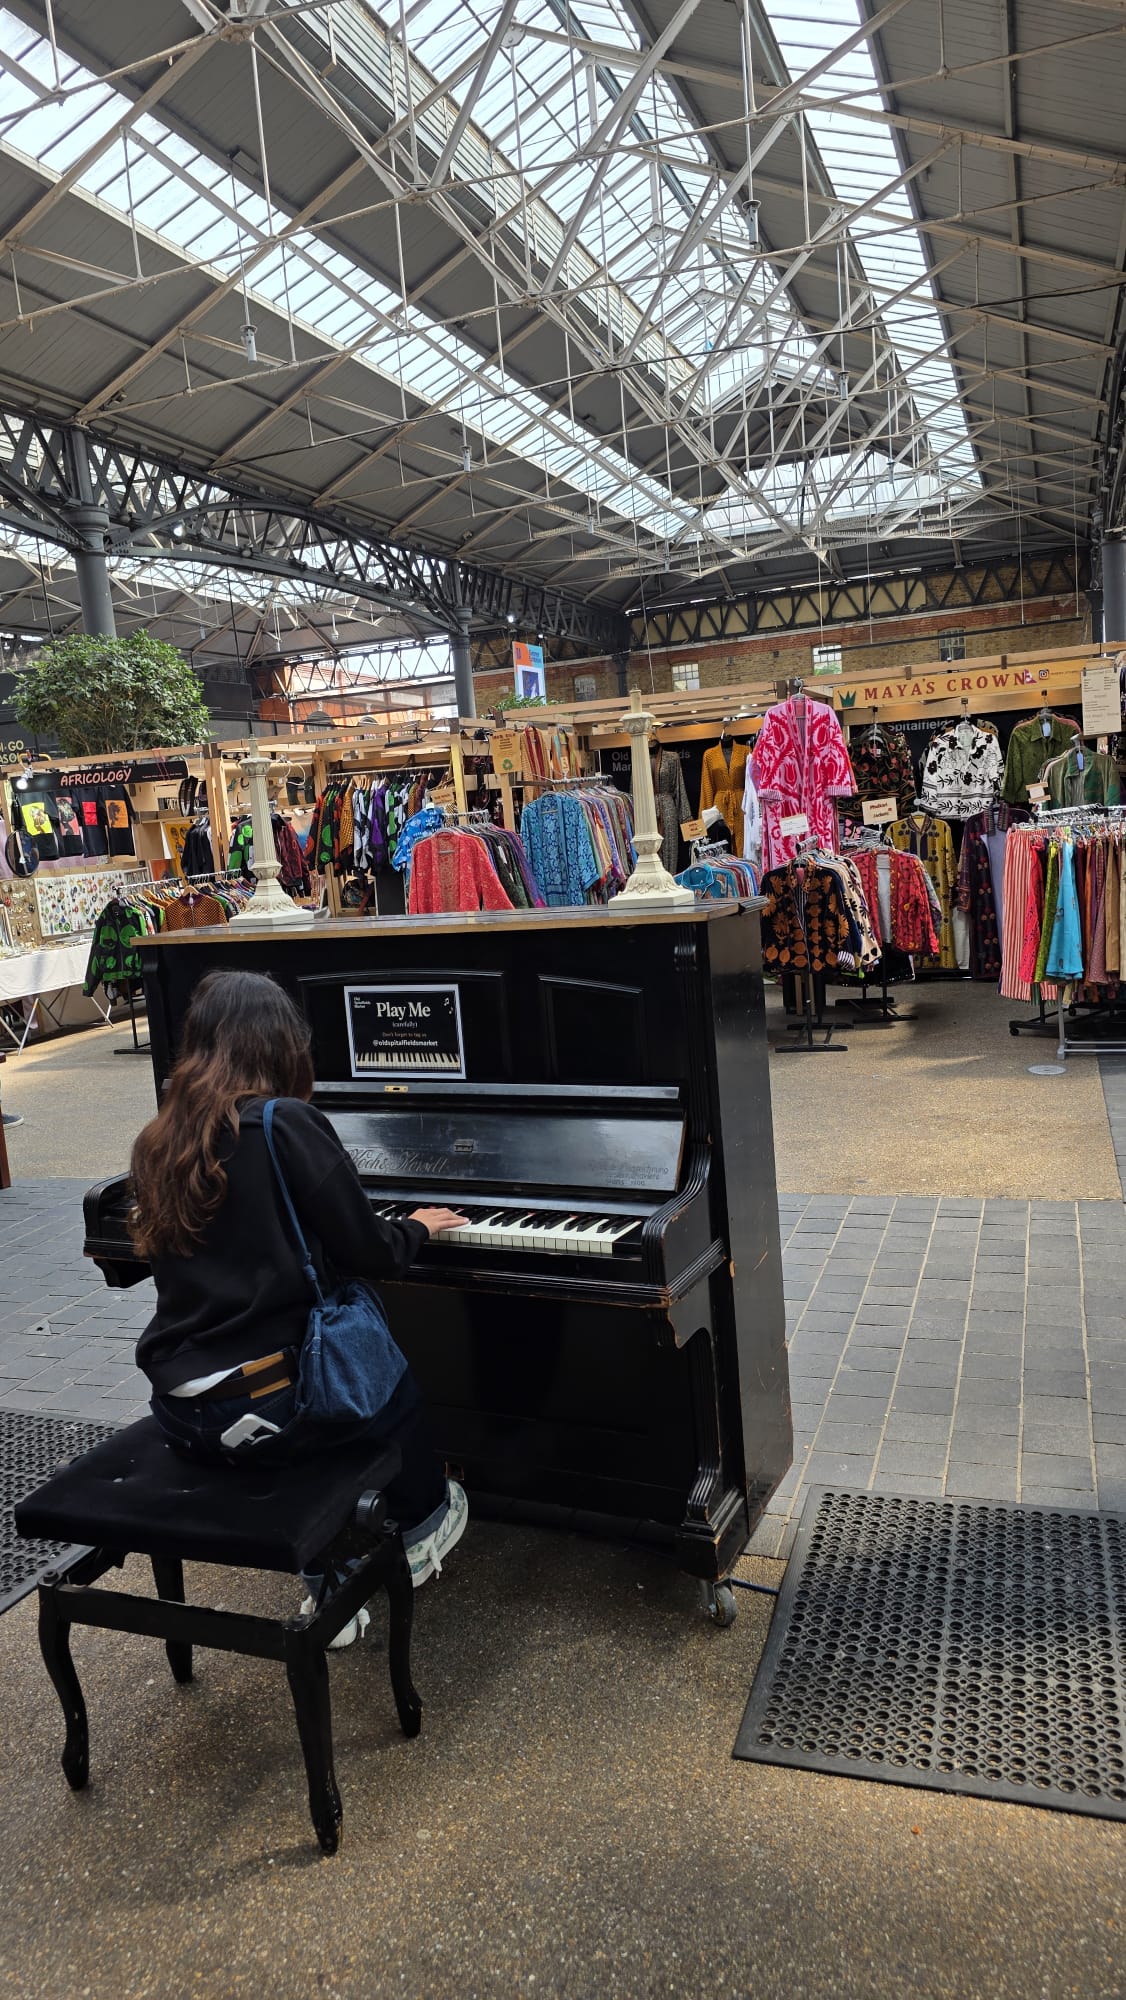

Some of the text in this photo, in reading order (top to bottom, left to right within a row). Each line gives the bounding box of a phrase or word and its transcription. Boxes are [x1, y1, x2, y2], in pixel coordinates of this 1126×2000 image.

[864, 672, 1026, 700] MAYA'S CROWN
[611, 751, 629, 761] Old
[60, 768, 131, 786] AFRICOLOGY
[376, 1002, 431, 1020] Play Me
[372, 1039, 438, 1047] @oldspitalfieldsmarket
